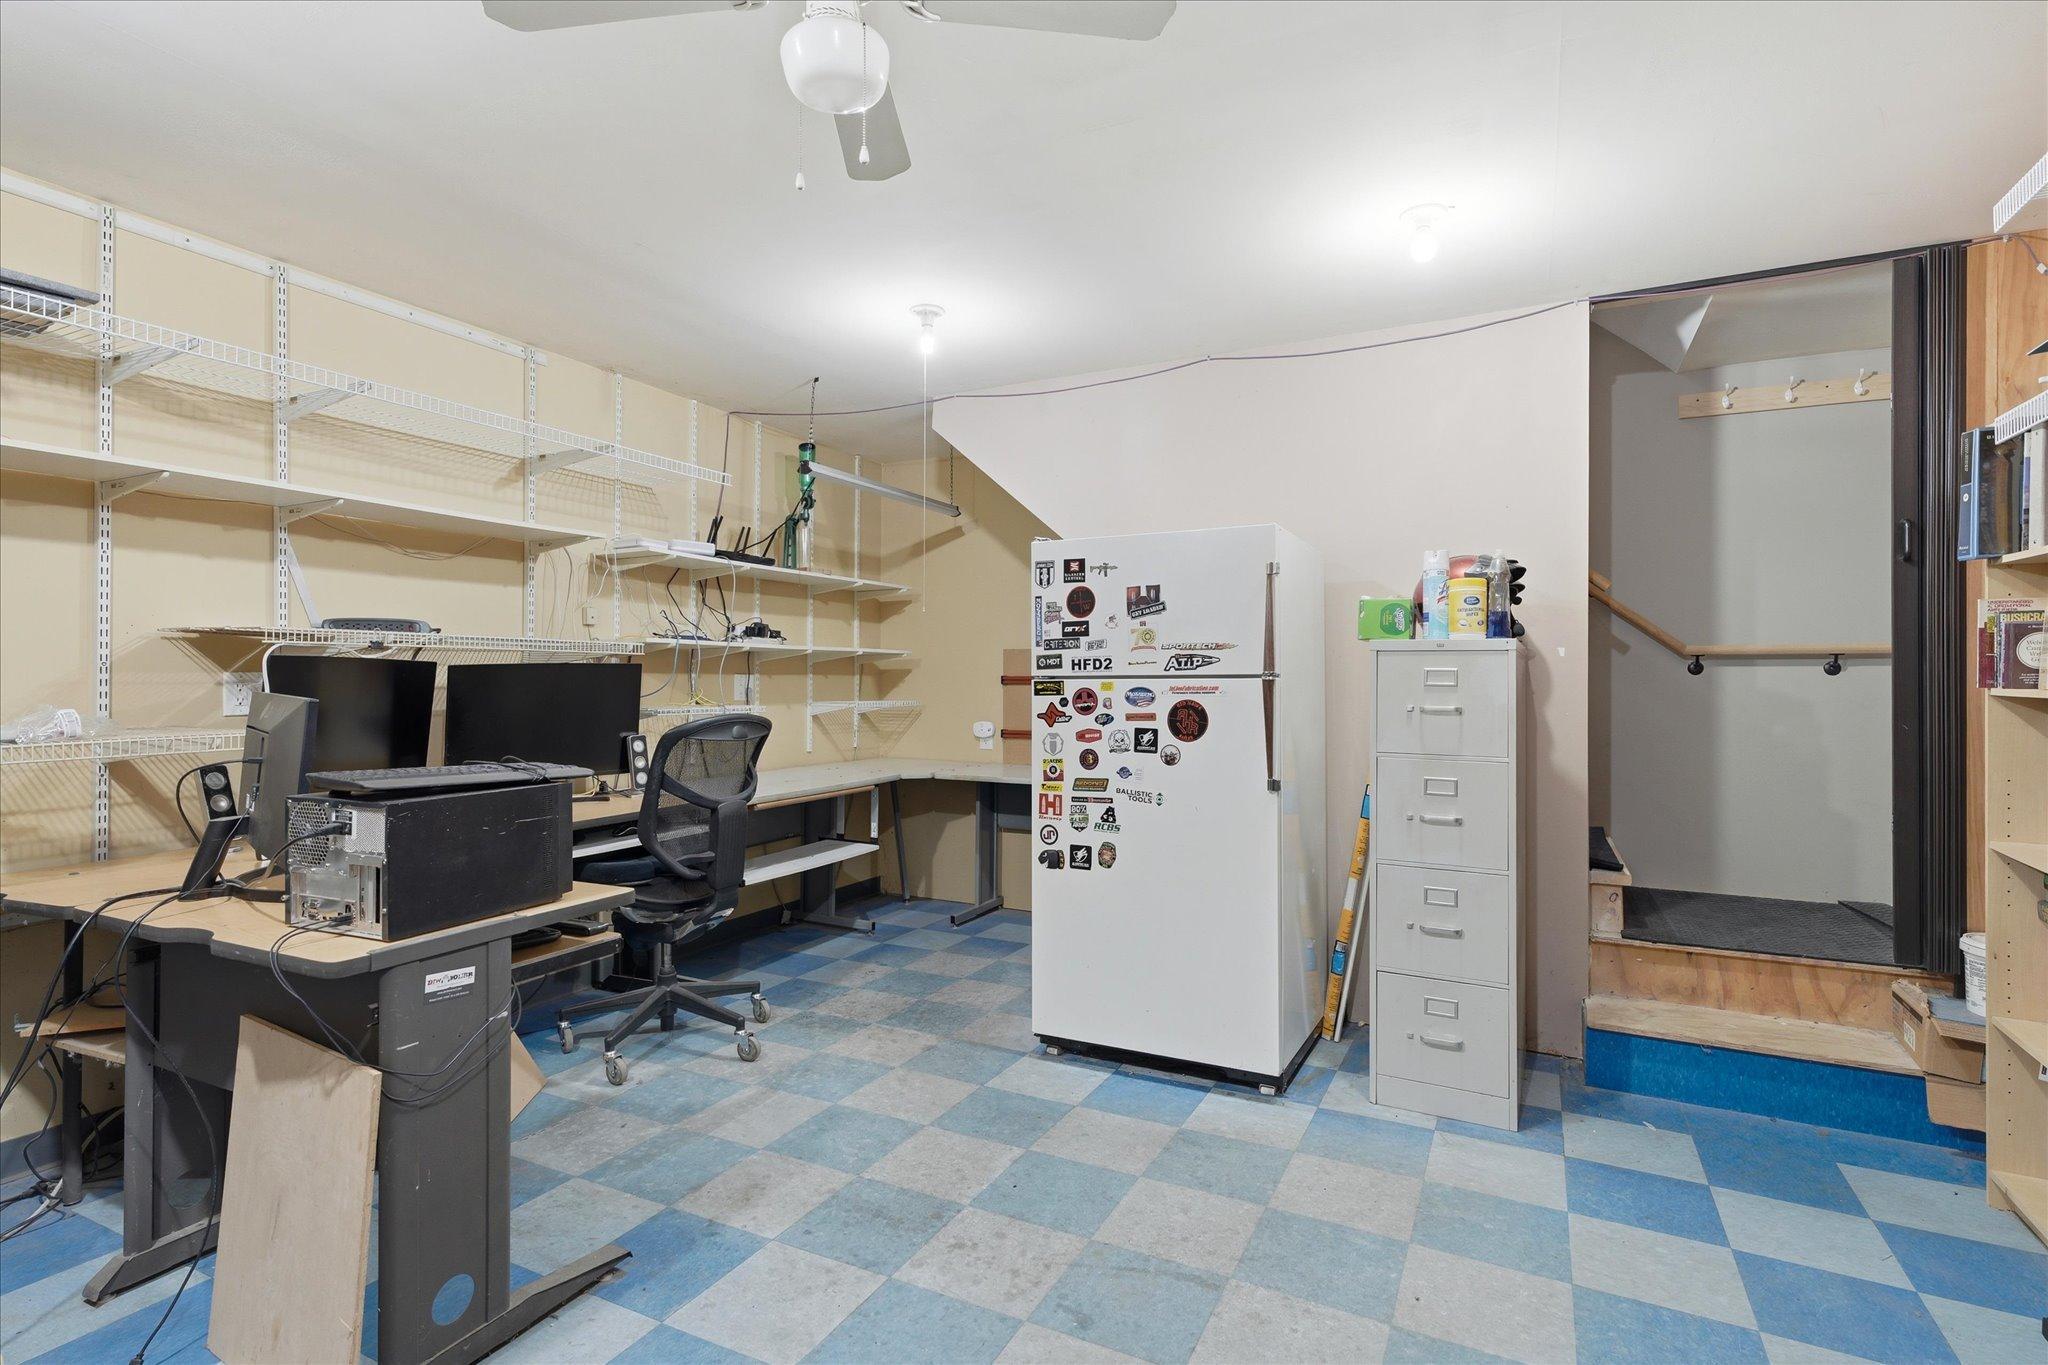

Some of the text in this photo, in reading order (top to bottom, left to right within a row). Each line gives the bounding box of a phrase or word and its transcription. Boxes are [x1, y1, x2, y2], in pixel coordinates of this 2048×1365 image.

[1044, 640, 1080, 649] CRITERION
[1071, 658, 1113, 670] HFD2
[1115, 787, 1153, 798] BALLISTIC
[1128, 795, 1153, 804] TOOLS
[1093, 822, 1122, 832] RCBS
